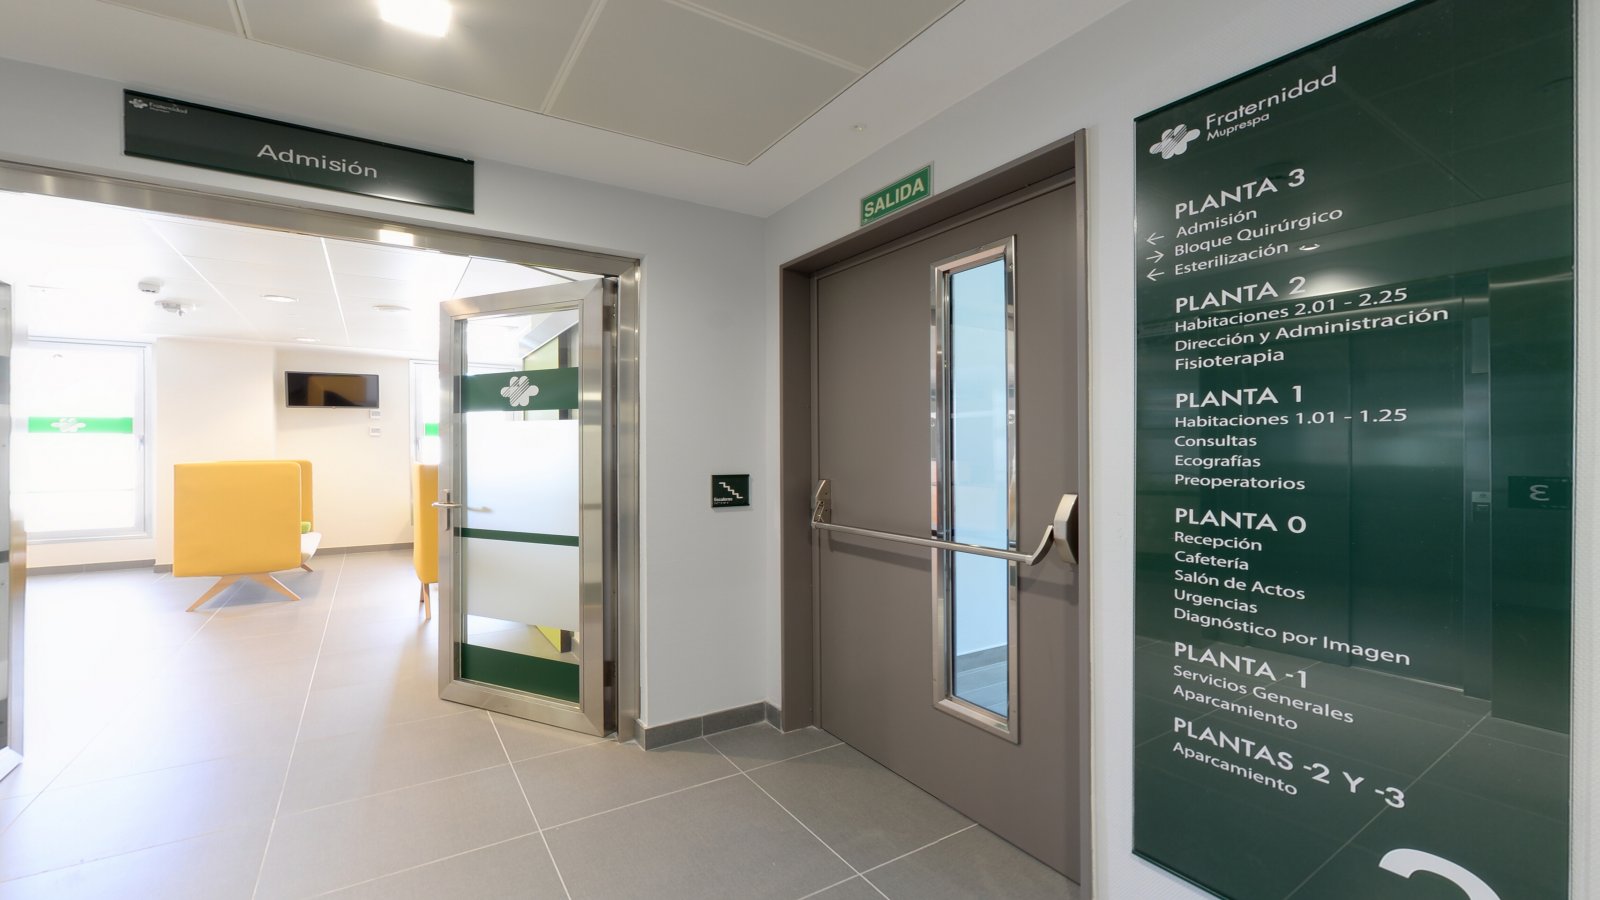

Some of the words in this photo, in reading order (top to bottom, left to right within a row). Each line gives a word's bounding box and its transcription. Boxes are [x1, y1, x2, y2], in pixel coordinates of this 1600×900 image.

[1206, 65, 1337, 130] Fraternidad
[1206, 113, 1270, 141] Muprespa
[256, 144, 378, 179] Admisión
[864, 177, 925, 217] SALIDA
[1175, 177, 1278, 219] PLANTA
[1288, 168, 1305, 188] 3
[1174, 233, 1233, 257] Bloque
[1236, 208, 1343, 242] Quirúrgico
[1176, 208, 1257, 238] Admisión
[1174, 242, 1289, 276] Esterilización
[1175, 281, 1279, 314] PLANTA
[1288, 276, 1307, 296] 2
[1175, 307, 1289, 333] Habitaciones
[1294, 298, 1335, 316] 2.01
[1358, 287, 1408, 308] 2.25
[1175, 330, 1254, 352] Dirección
[1259, 331, 1271, 345] y
[1275, 308, 1449, 340] Administración
[1175, 349, 1284, 371] Fisioterapia
[1175, 386, 1279, 409] PLANTA
[1292, 385, 1302, 403] 1
[1175, 412, 1289, 428] Habitaciones
[1295, 411, 1335, 425] 1.01
[1359, 408, 1408, 423] 1.25
[1174, 435, 1257, 448] Consultas
[1174, 455, 1261, 469] Ecografías
[1174, 474, 1306, 491] Preoperatorios
[1175, 507, 1278, 532] PLANTA
[1174, 531, 1262, 551] Recepción
[1174, 551, 1249, 571] Cafetería
[1174, 569, 1219, 587] Salón
[1224, 577, 1247, 591] de
[1251, 581, 1306, 600] Actos
[1174, 588, 1258, 614] Urgencias
[1174, 607, 1277, 639] Diagnóstico
[1282, 630, 1318, 651] por
[1323, 636, 1411, 666] Imagen
[1174, 641, 1277, 682] PLANTA
[1285, 670, 1307, 689] -1
[1173, 664, 1247, 695] Servicios
[1252, 686, 1354, 724] Generales
[1173, 684, 1298, 731] Aparcamiento
[1173, 742, 1298, 796] Aparcamiento
[1174, 717, 1294, 771] PLANTAS
[1303, 762, 1330, 784] -2
[1342, 770, 1365, 794] Y
[1374, 786, 1405, 809] -3
